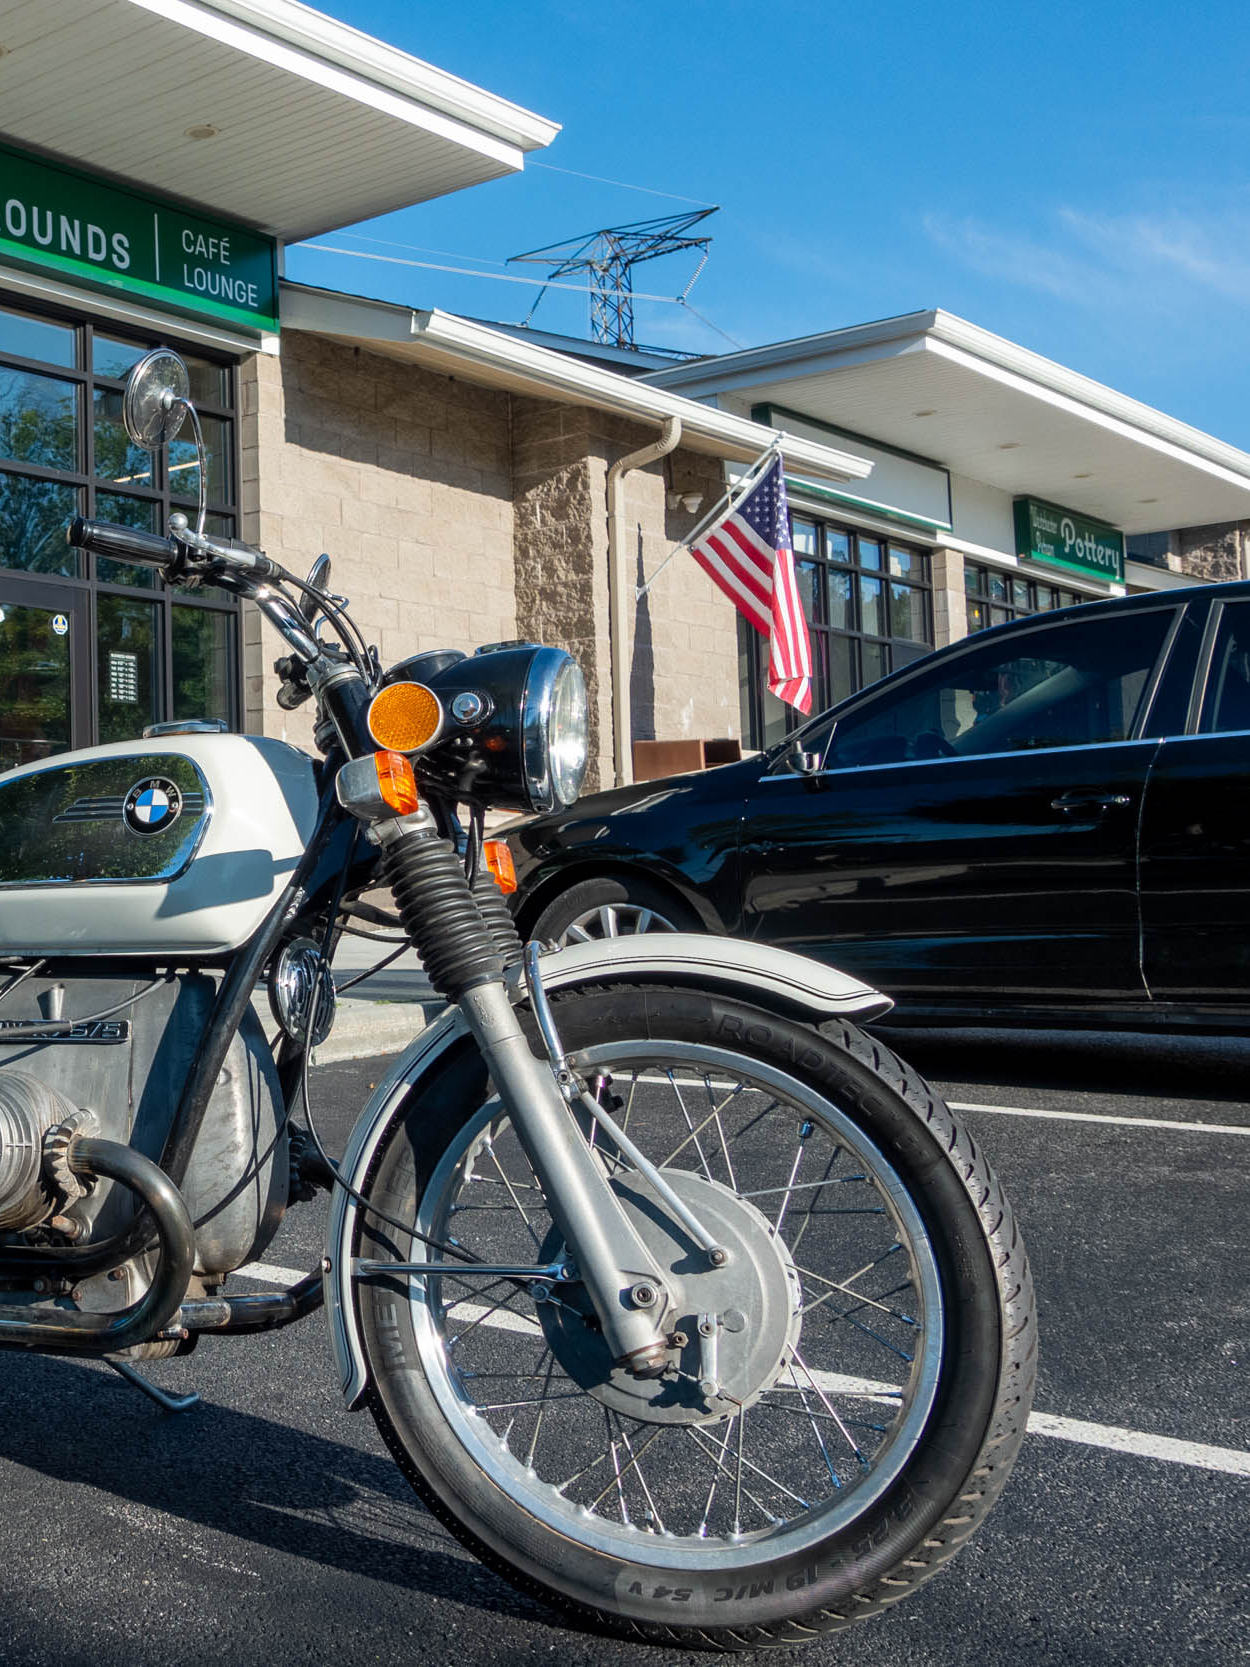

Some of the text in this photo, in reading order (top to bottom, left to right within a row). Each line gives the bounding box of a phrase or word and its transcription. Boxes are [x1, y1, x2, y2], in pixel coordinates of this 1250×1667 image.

[182, 229, 231, 265] CAFÉ
[183, 263, 258, 308] LOUNGE
[1061, 517, 1120, 580] Pottery
[132, 780, 177, 798] BMW
[714, 1579, 775, 1602] M/C
